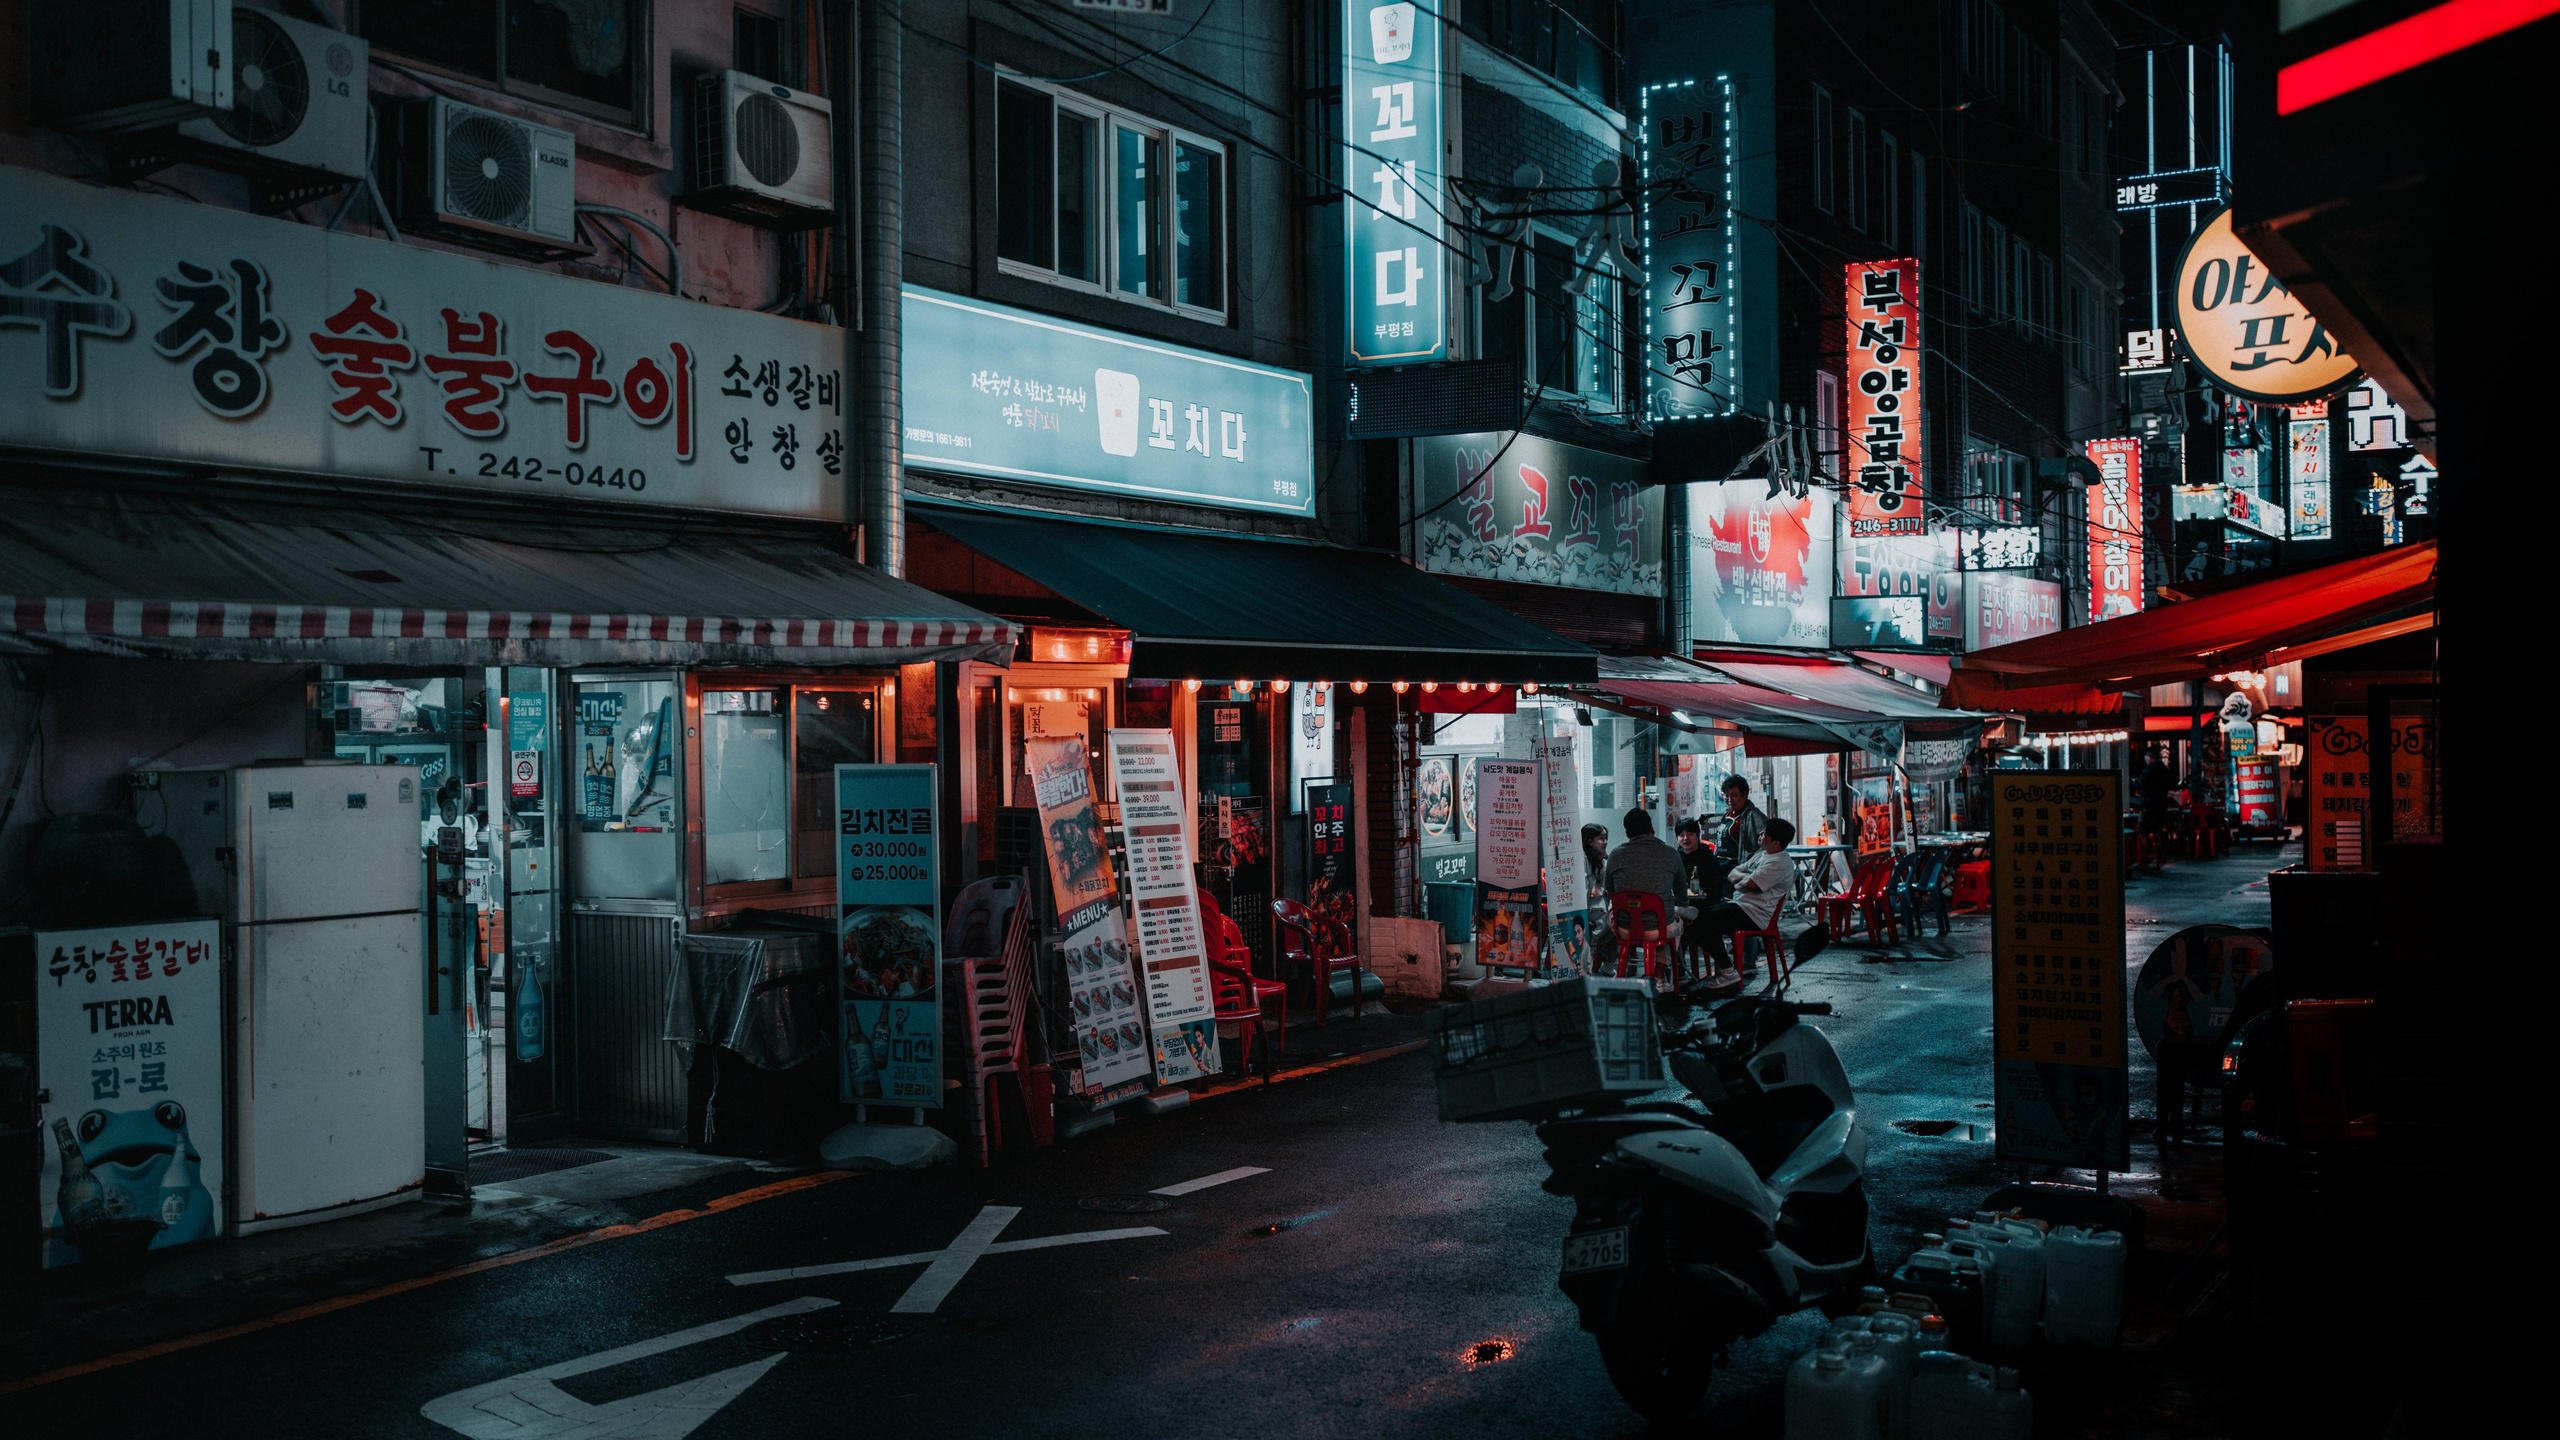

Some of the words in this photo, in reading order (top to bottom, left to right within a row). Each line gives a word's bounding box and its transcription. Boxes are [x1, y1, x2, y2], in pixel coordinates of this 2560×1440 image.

[327, 78, 349, 98] LG
[539, 151, 569, 169] KLASSE
[1370, 81, 1423, 306] 꼬치다
[1658, 110, 1725, 385] 벌교꼬막
[1374, 320, 1414, 339] 부평점
[309, 288, 690, 456] 숯불구이
[721, 354, 841, 416] 소생갈비
[1013, 379, 1023, 397] &
[1025, 379, 1055, 403] 직화로
[1857, 268, 1913, 514] 부성양곱창
[1002, 402, 1023, 428] 명품
[1148, 396, 1247, 463] 꼬치다
[725, 417, 844, 475] 안창살
[935, 432, 972, 448] 1661-9811
[478, 452, 646, 492] 242-0440
[1272, 480, 1298, 497] 부평점
[2303, 478, 2317, 513] 노래방
[1456, 447, 1644, 565] 벌교꼬막
[1853, 517, 1921, 535] 246-3117
[1690, 532, 1711, 550] hinese
[1712, 536, 1742, 554] Restaurant
[582, 699, 616, 722] 대선
[1137, 757, 1156, 766] 22,000
[1483, 764, 1504, 775] 남도맛
[1505, 765, 1533, 775] 계절음식
[1498, 776, 1517, 784] 해물탕
[1142, 794, 1160, 803] 39,000
[1498, 789, 1517, 797] 꽃게탕
[1313, 804, 1344, 822] 꼬치
[1492, 802, 1523, 811] 해물김치탕
[840, 808, 932, 835] 김치전골
[1313, 821, 1345, 839] 안주
[1489, 818, 1526, 827] 꼬막해물볶음
[1489, 830, 1526, 839] 갑오징어볶음
[865, 841, 927, 859] 30,000원
[1314, 837, 1345, 855] 최고
[1489, 846, 1526, 855] 갑오징어무침
[1435, 855, 1467, 879] 벌교꼬막
[1492, 857, 1523, 866] 가오리무침
[865, 864, 928, 882] 25,000원
[1495, 868, 1520, 877] 꼬막무침
[1072, 902, 1102, 931] MENU
[83, 995, 174, 1034] TERRA
[114, 1031, 134, 1039] FROM
[135, 1029, 151, 1037] AGM
[92, 1044, 136, 1063] 소주의
[138, 1041, 167, 1058] 원조
[892, 1038, 934, 1063] 대선
[1657, 1141, 1702, 1154] PCX
[1579, 1243, 1622, 1267] 2705
